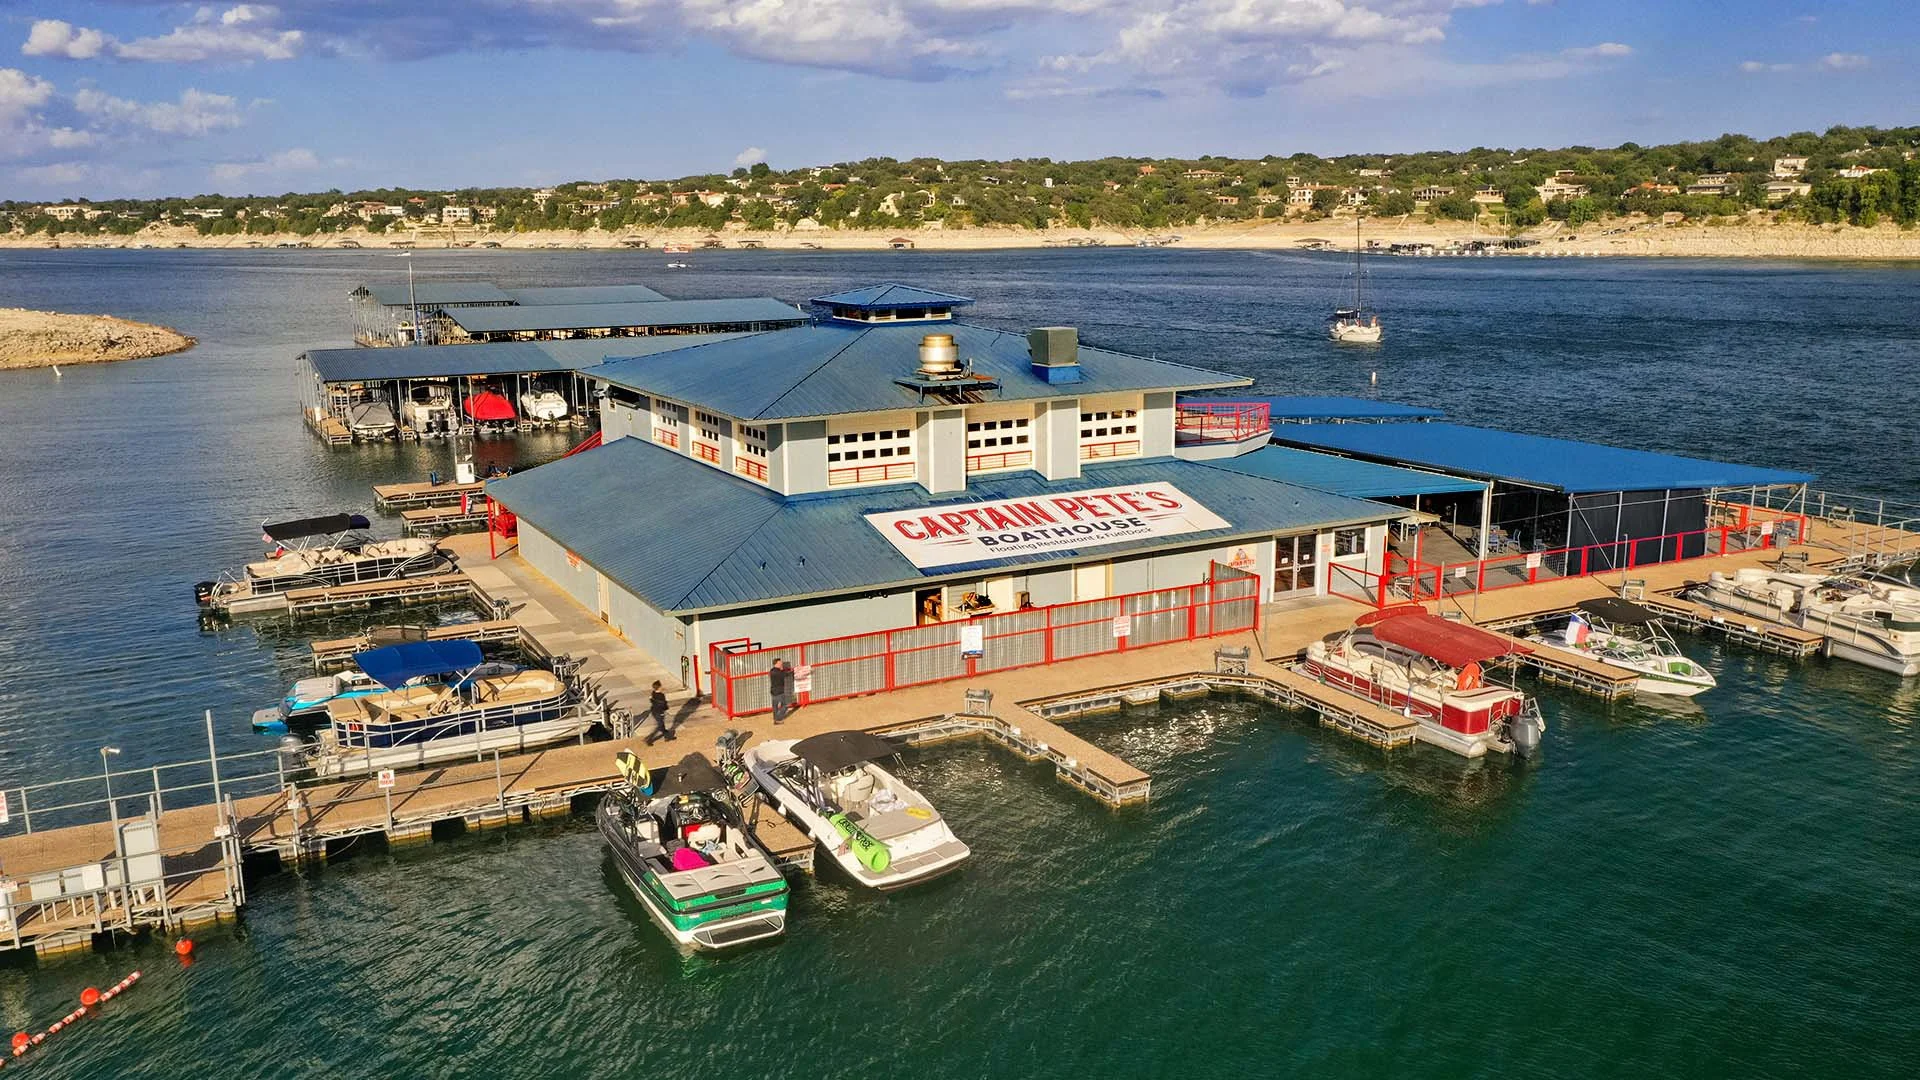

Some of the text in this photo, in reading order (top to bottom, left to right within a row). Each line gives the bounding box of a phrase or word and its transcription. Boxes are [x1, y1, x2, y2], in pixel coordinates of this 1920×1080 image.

[894, 491, 1182, 541] CAPTAIN PETE'S
[977, 517, 1146, 546] BOATHOUSE
[989, 543, 1038, 553] Floating
[1036, 535, 1095, 547] Restaurant
[1104, 530, 1127, 538] Fuel
[1126, 527, 1152, 535] Dock
